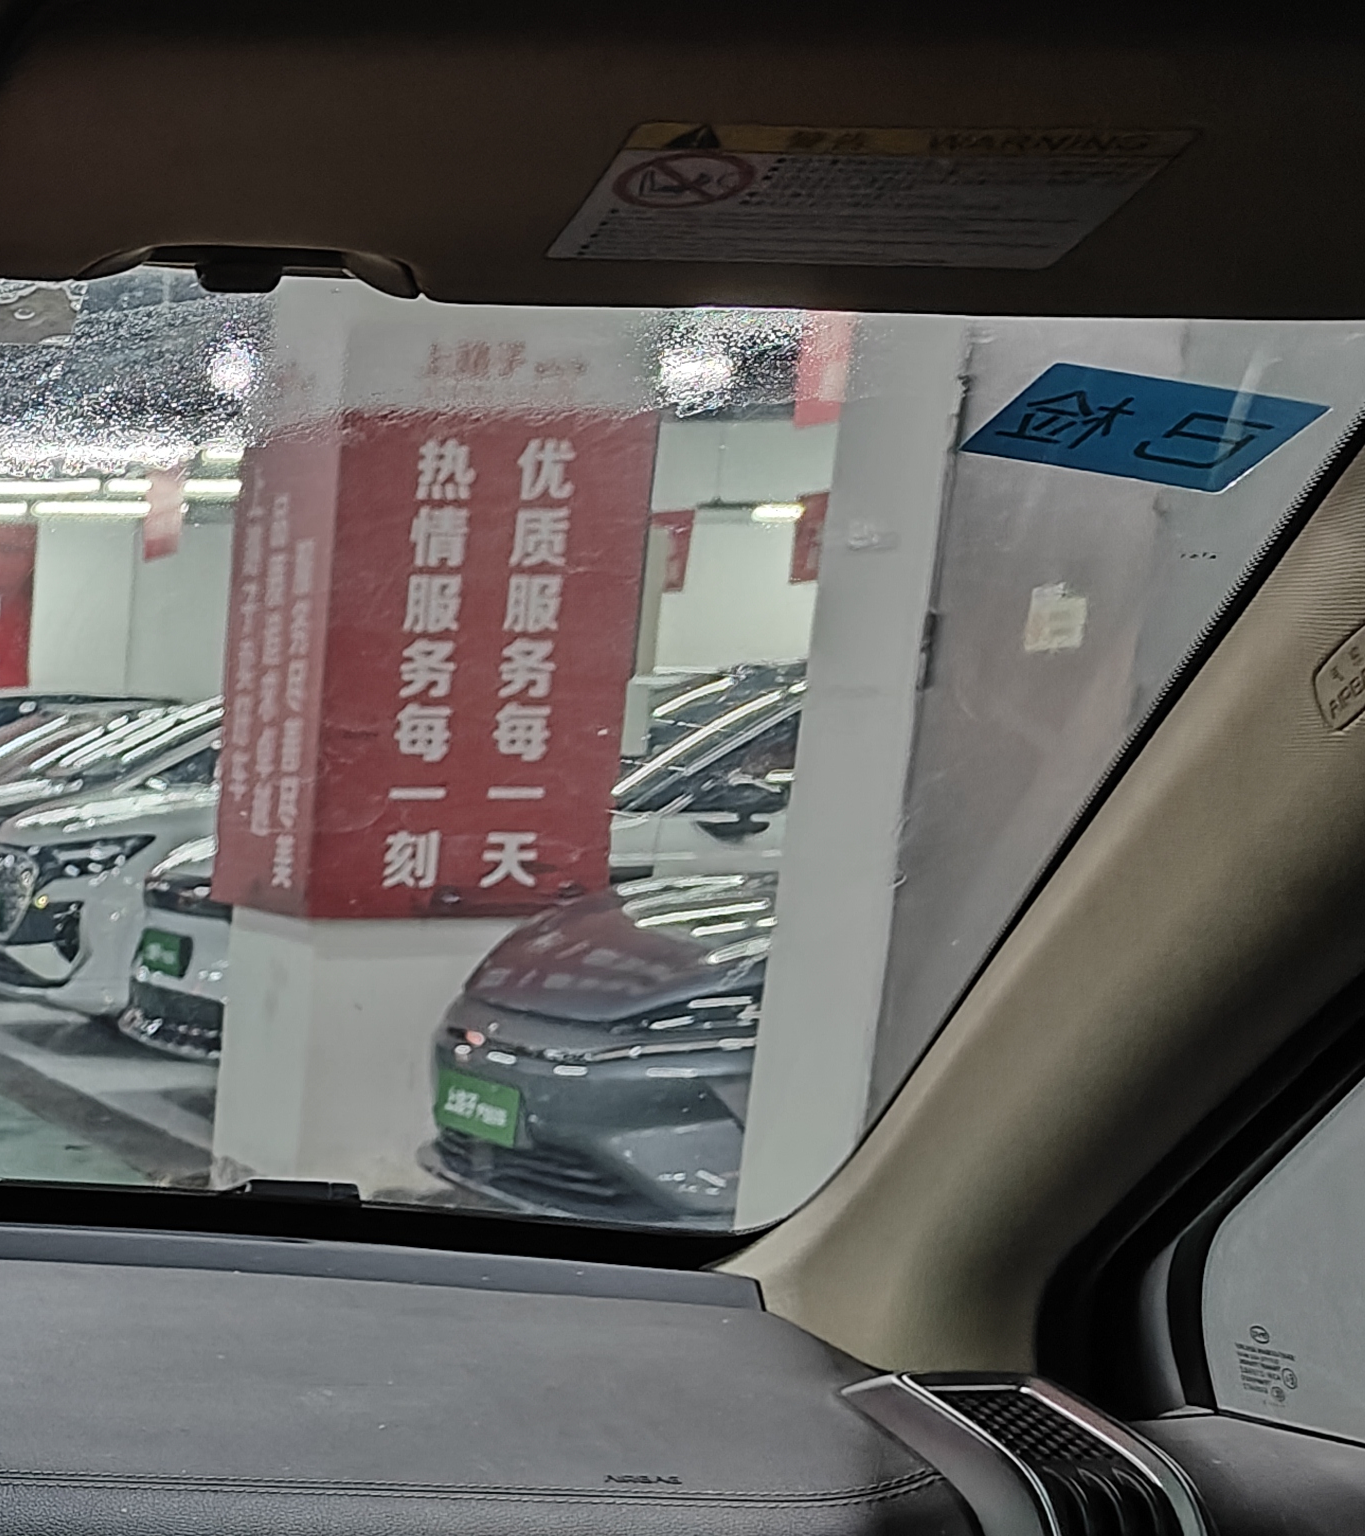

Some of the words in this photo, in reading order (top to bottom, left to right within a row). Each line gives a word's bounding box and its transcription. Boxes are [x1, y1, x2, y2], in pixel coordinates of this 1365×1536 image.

[926, 132, 1153, 154] WARNING
[381, 438, 476, 888] 热情服务每一刻
[478, 438, 576, 888] 优质服务每一天
